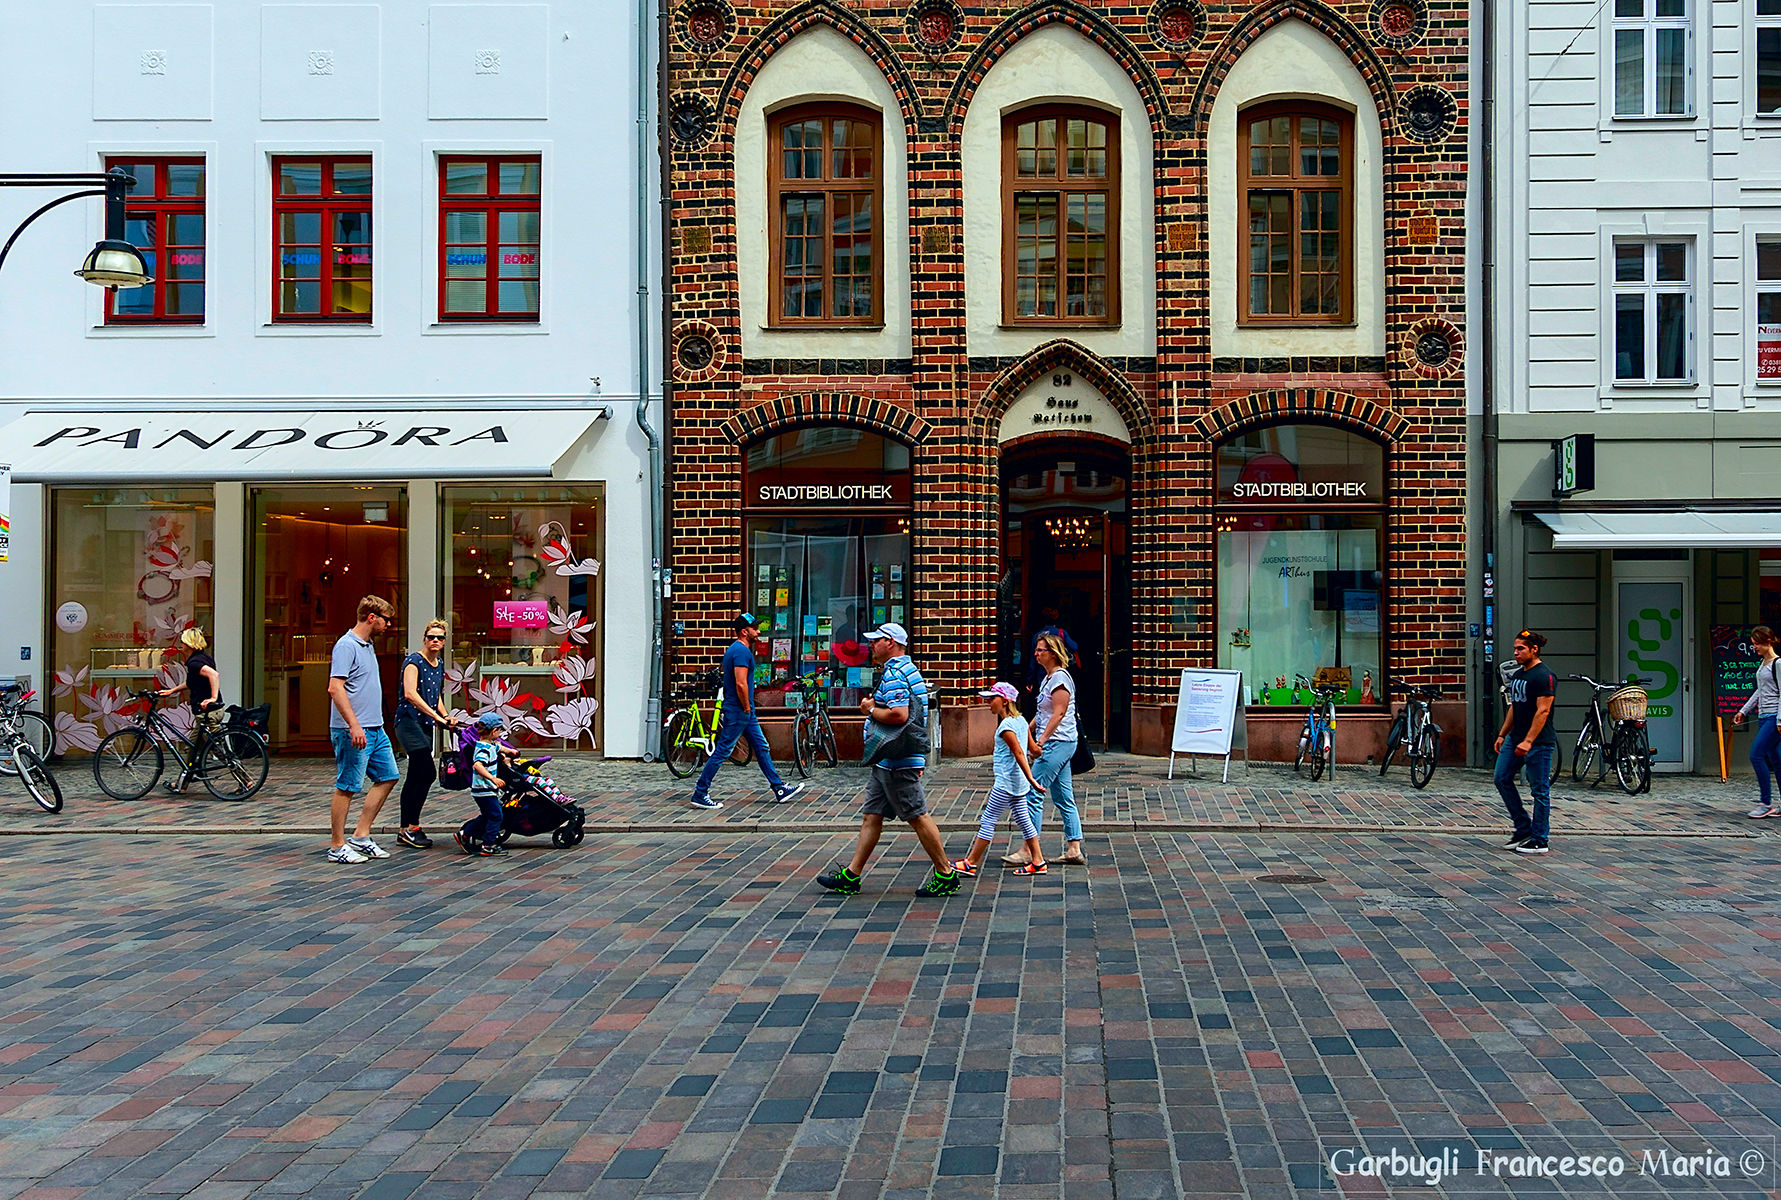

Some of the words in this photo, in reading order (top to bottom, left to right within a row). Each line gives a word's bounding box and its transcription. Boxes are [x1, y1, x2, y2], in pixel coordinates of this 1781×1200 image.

[171, 254, 202, 265] BODE
[282, 253, 321, 265] SCHUH
[337, 253, 369, 264] BODE
[447, 253, 487, 265] SCHUH
[503, 253, 535, 265] BODE
[1053, 374, 1072, 387] 82
[1046, 396, 1079, 409] Haus
[33, 425, 510, 450] PANDORA
[759, 485, 893, 500] STADTBIBLIOTHEK
[1233, 482, 1367, 498] STADTBIBLIOTHEK
[1262, 555, 1328, 564] JUGENDKUNSTSCHULE
[496, 606, 515, 623] SALE
